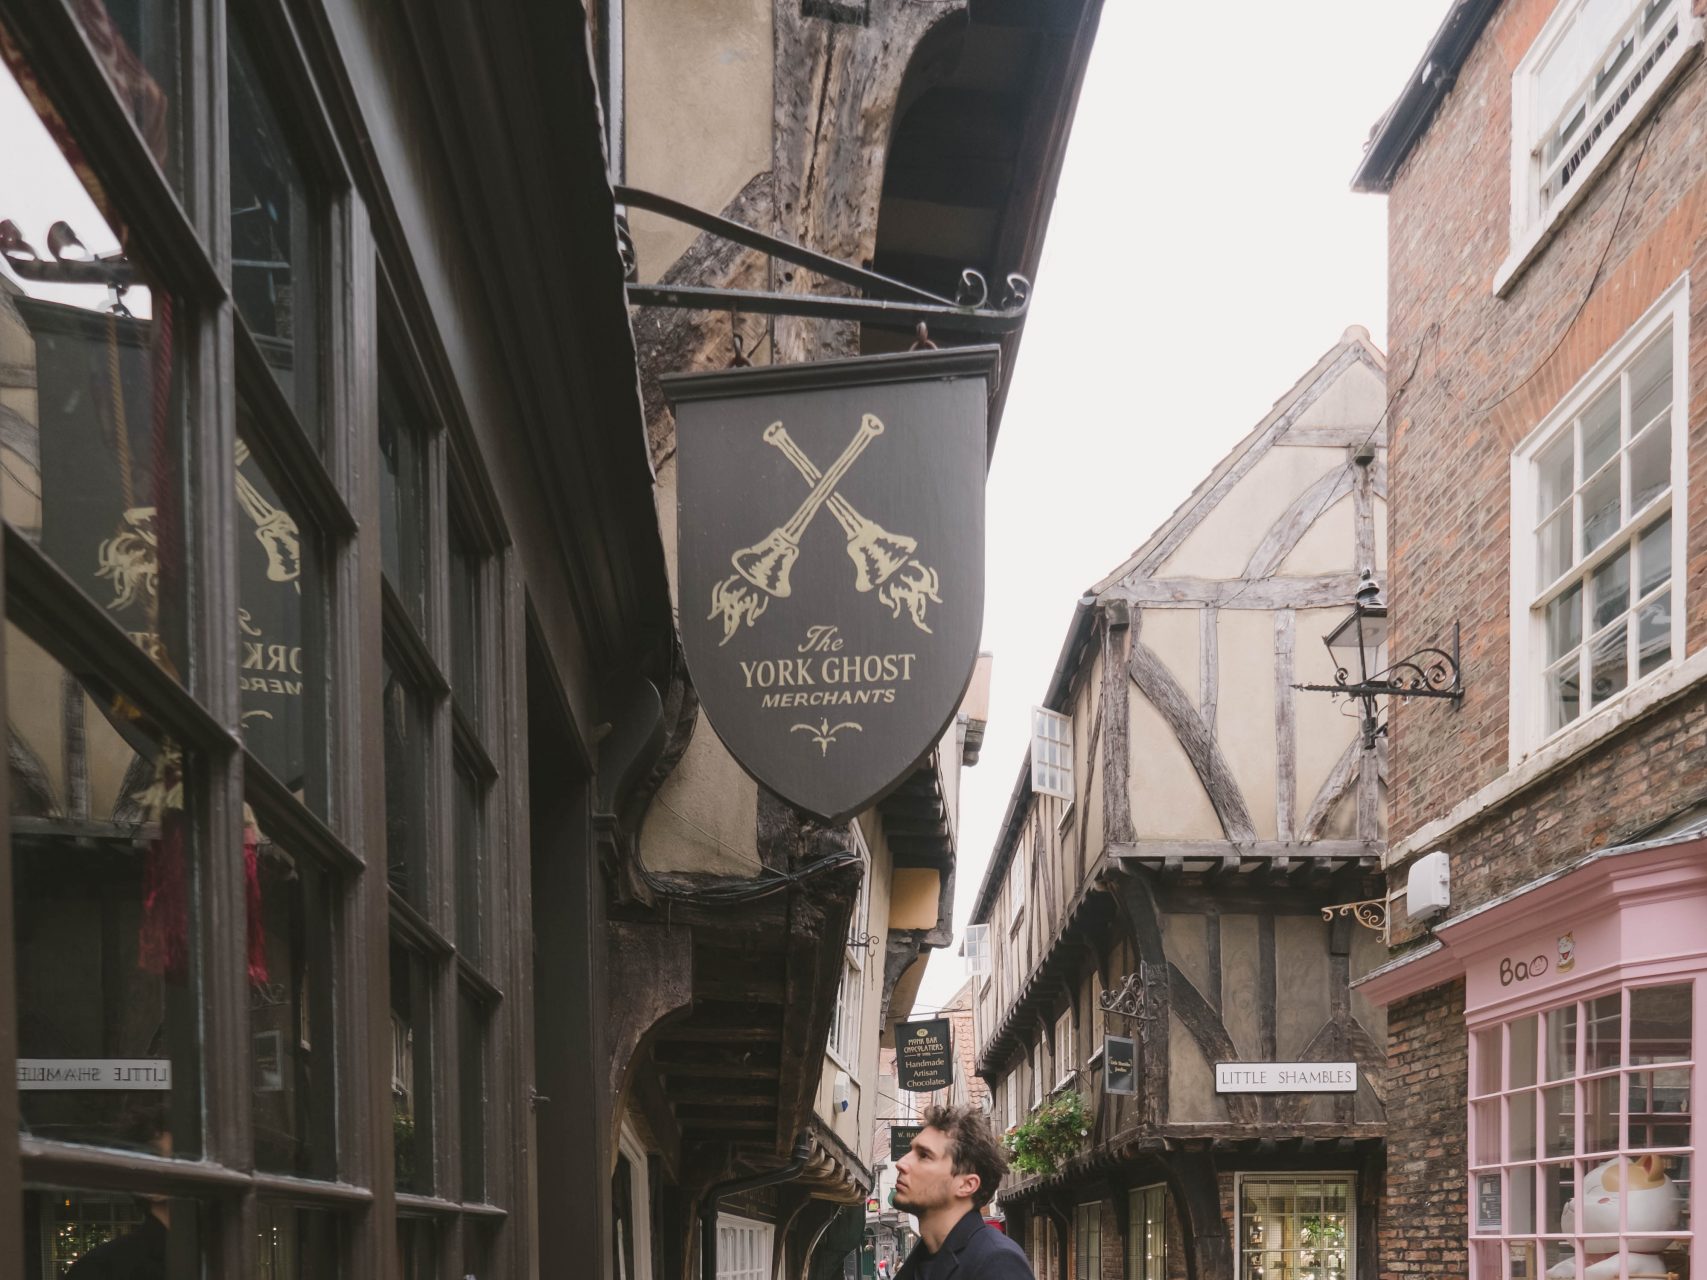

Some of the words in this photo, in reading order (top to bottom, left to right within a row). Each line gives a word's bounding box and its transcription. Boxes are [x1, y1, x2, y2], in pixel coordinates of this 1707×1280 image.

[798, 625, 844, 653] The
[740, 657, 815, 688] YORK
[822, 654, 916, 684] GHOST
[761, 689, 896, 708] MERCHANTS
[1500, 955, 1548, 987] Bao
[926, 1036, 937, 1045] BAR
[905, 1058, 945, 1069] Handmade
[913, 1069, 938, 1078] Artisan
[1222, 1071, 1267, 1085] LITTLE
[1278, 1070, 1352, 1084] SHAMBLES
[906, 1078, 946, 1088] Chocolates
